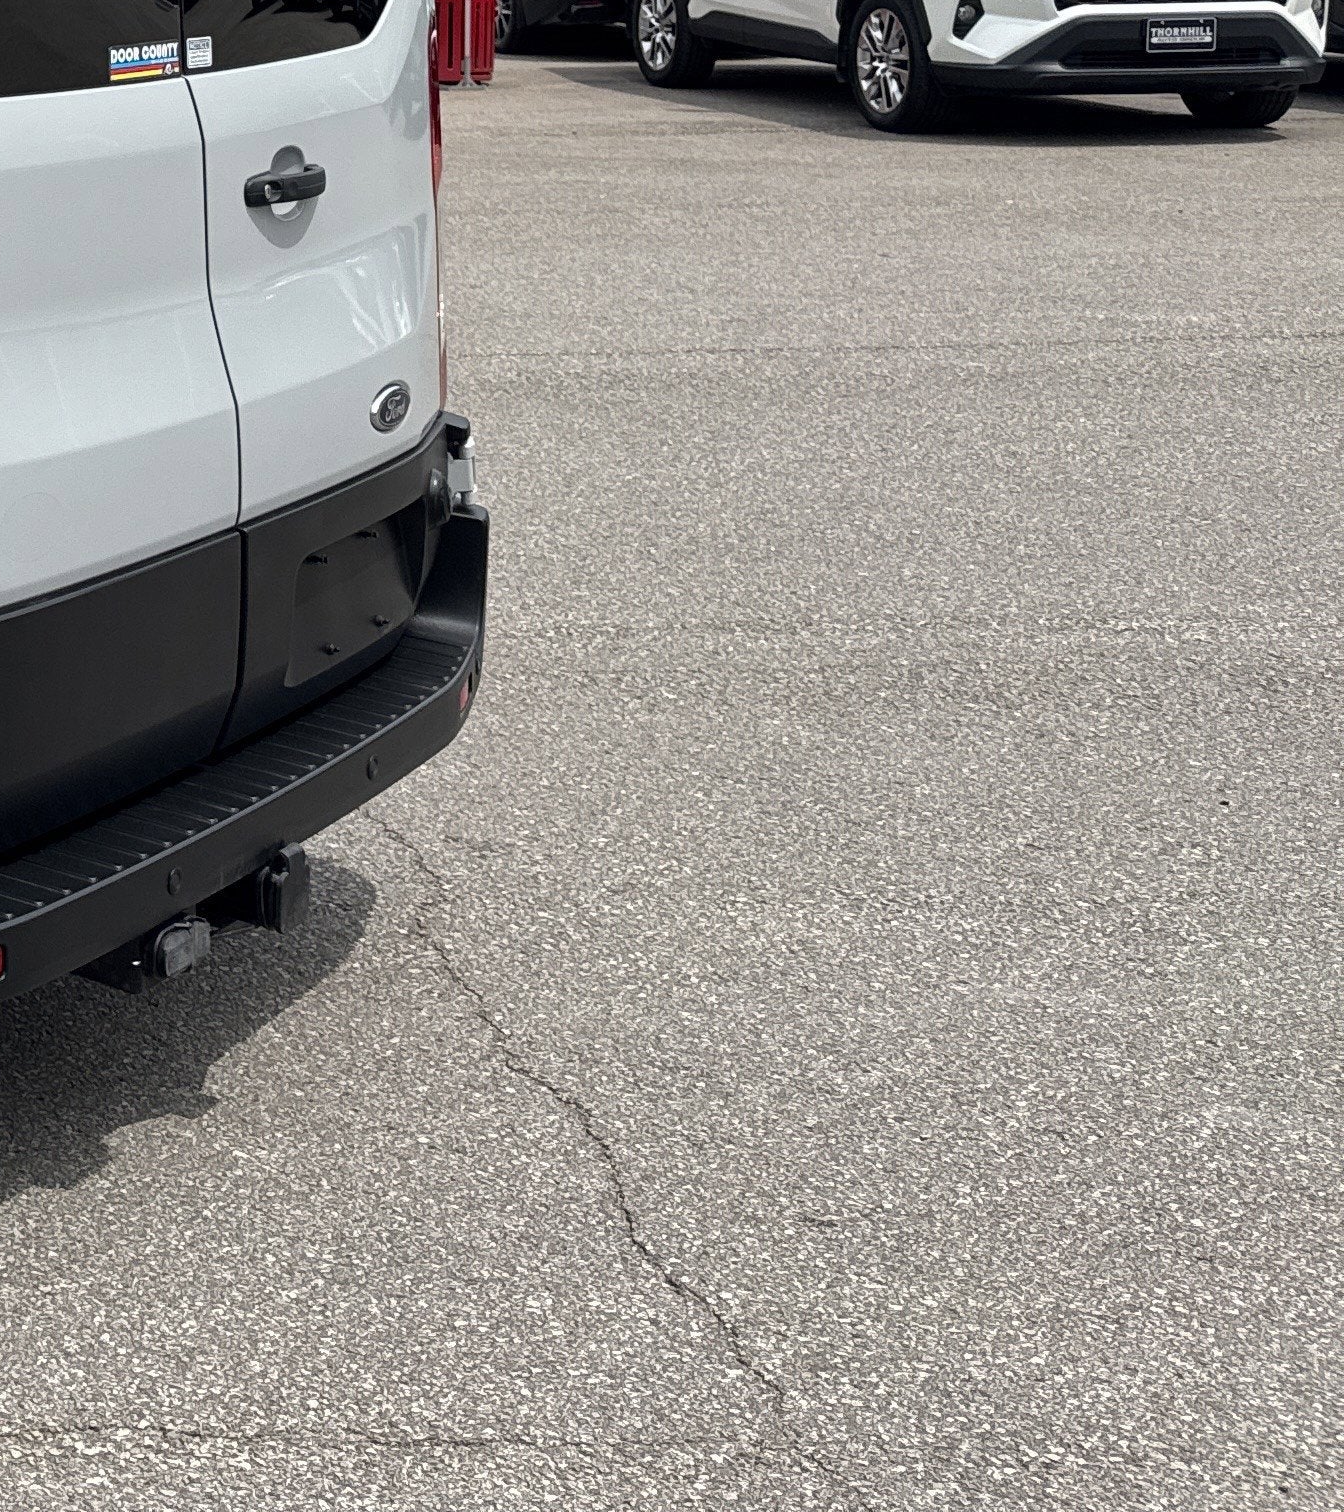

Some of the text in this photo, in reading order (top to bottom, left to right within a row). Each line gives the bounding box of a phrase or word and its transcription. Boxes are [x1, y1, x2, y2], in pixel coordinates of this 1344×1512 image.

[1150, 26, 1213, 37] THORNHILL
[110, 46, 140, 64] DOOR
[141, 42, 179, 60] COUNTY
[385, 394, 405, 422] Ford
